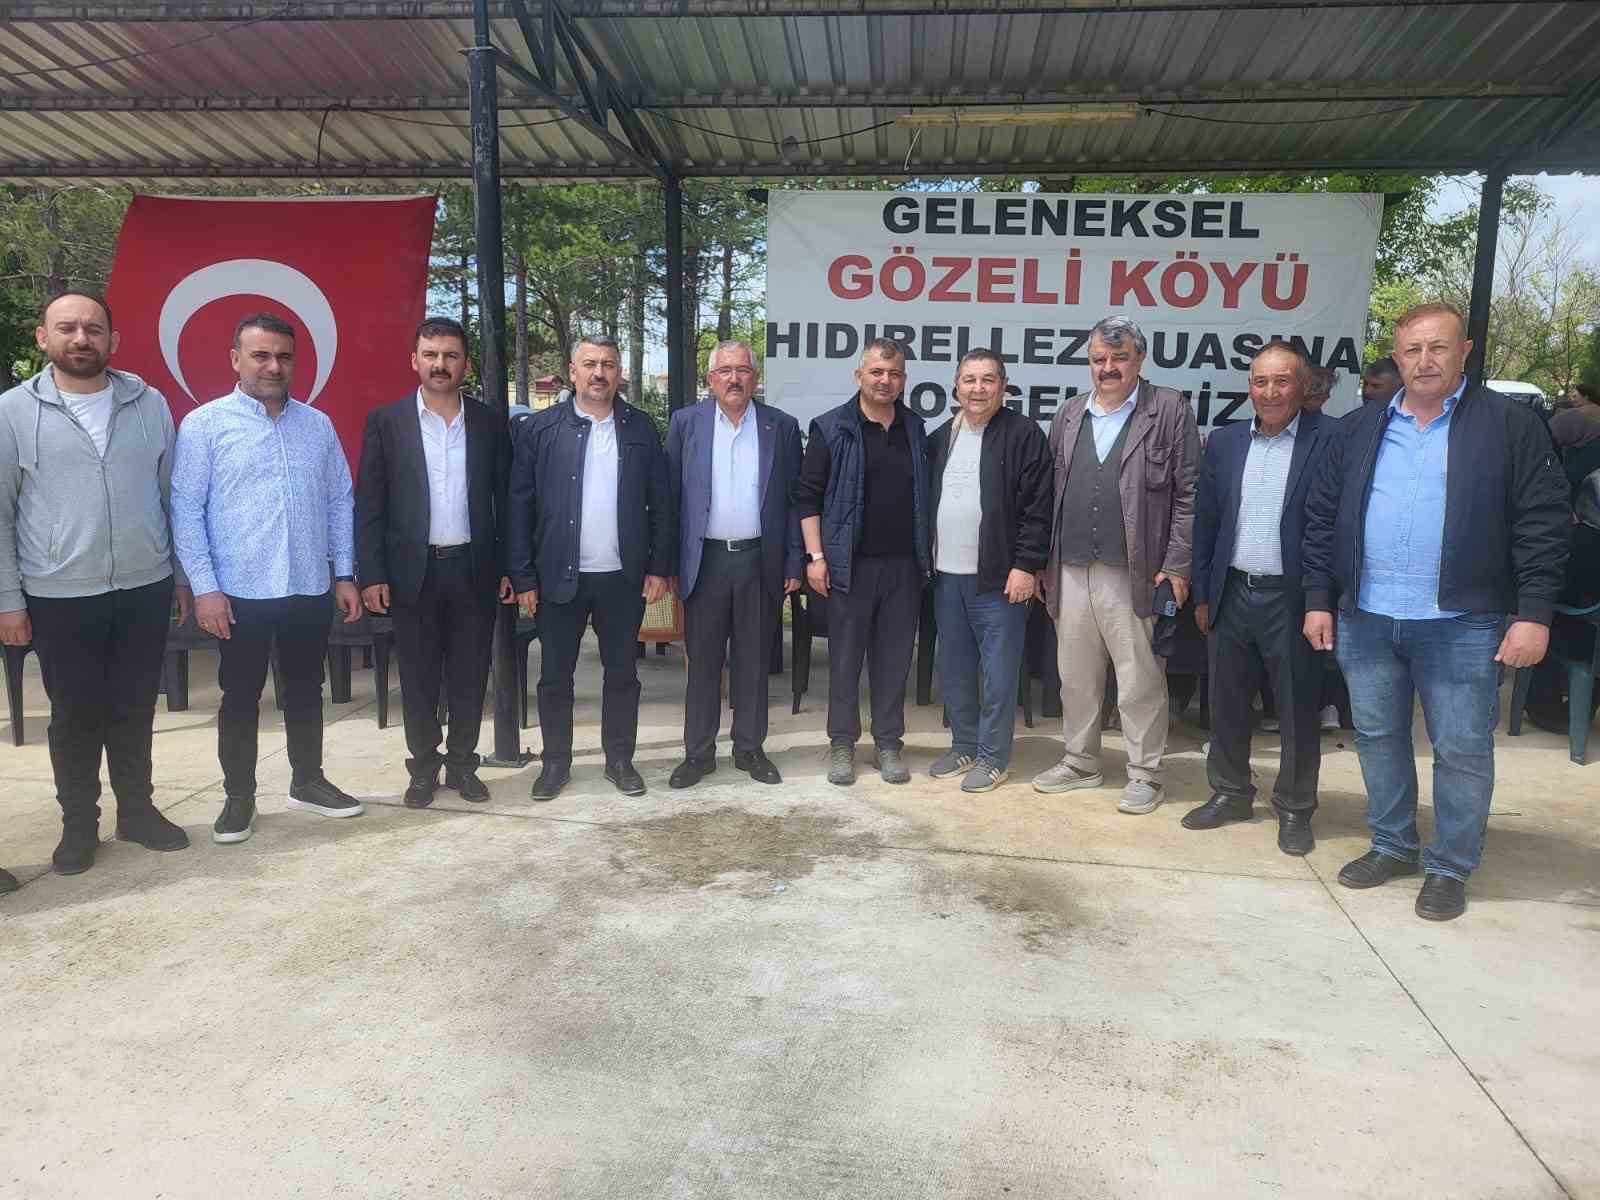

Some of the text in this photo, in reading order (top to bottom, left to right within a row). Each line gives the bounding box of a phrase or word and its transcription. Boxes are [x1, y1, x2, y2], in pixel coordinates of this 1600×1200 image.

[883, 197, 1260, 238] GELENEKSEL
[828, 247, 1308, 310] GÖZELİ KÖYÜ
